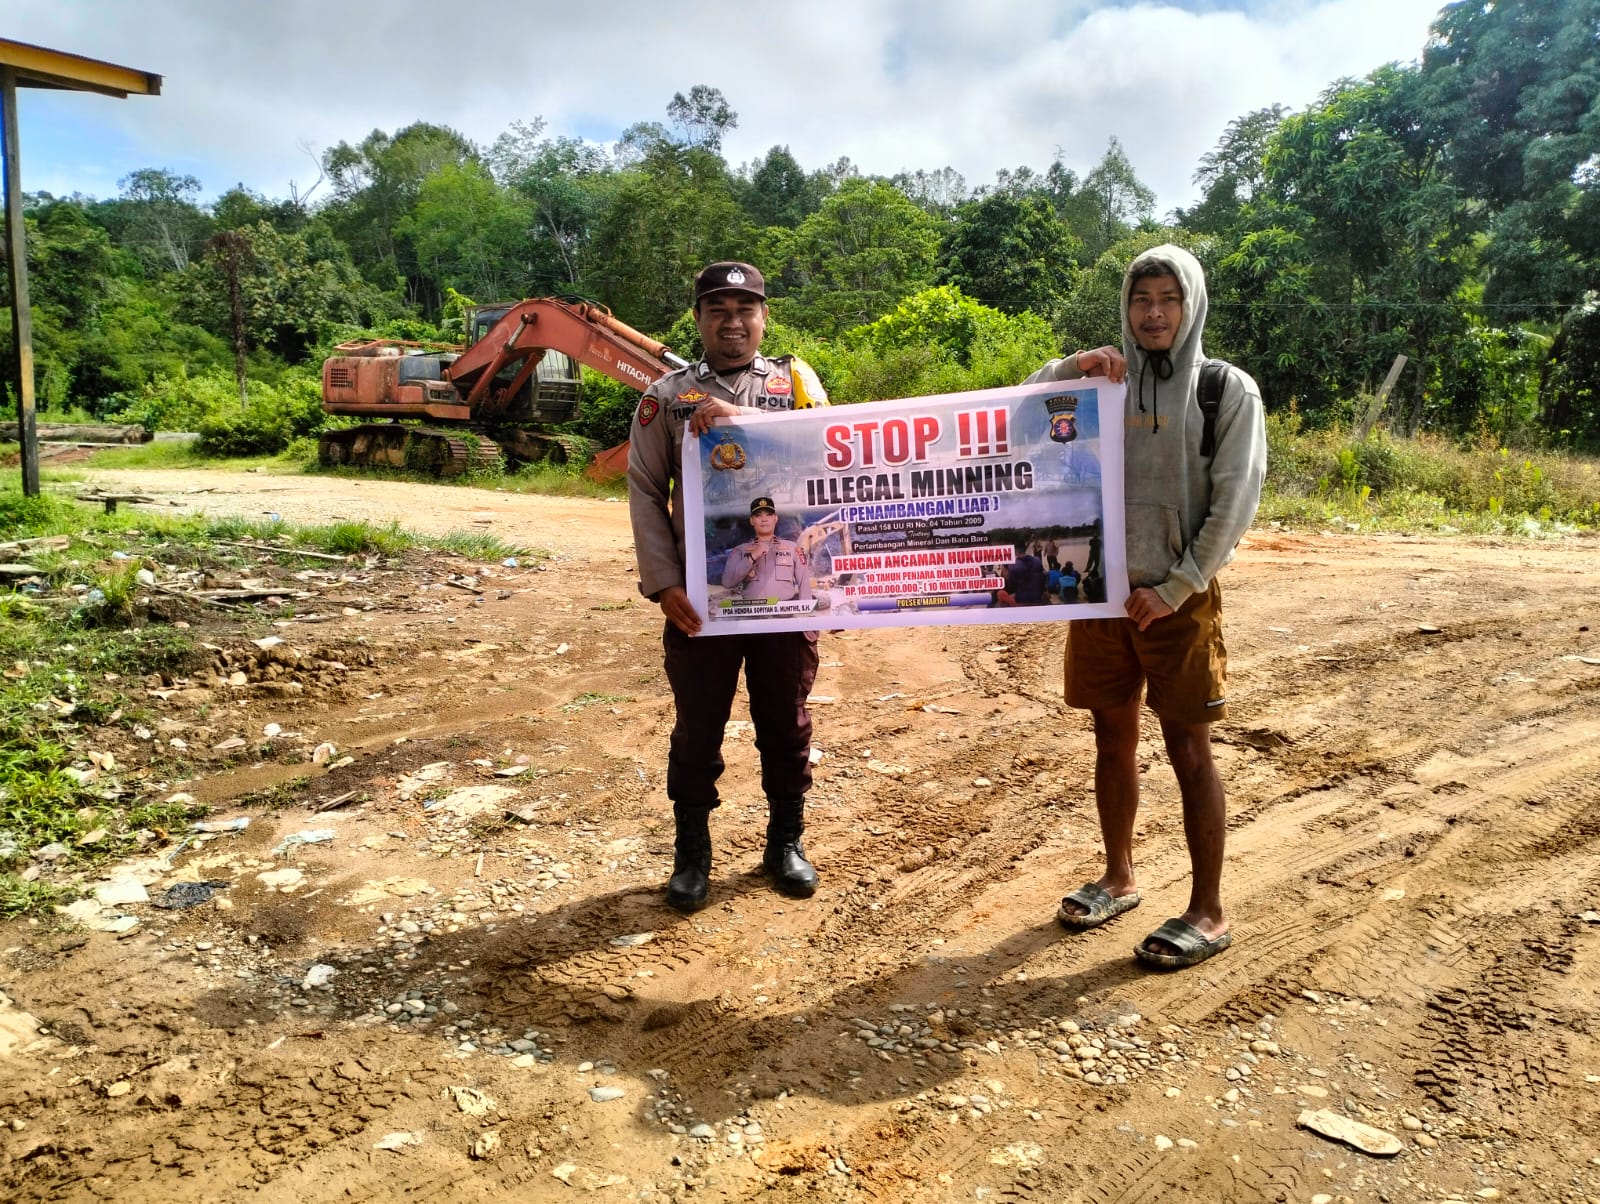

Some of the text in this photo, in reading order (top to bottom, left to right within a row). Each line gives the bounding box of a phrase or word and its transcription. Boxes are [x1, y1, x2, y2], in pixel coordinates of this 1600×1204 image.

[617, 359, 652, 386] HITACHI
[826, 408, 1009, 469] STOP !!!
[806, 461, 1034, 506] ILLEGAL MINNING
[849, 500, 955, 522] PENAMBANGAN
[958, 497, 990, 514] LIAR
[857, 524, 877, 532] Pasal
[879, 523, 891, 531] 158
[916, 521, 928, 529] No.
[940, 519, 963, 527] Tahun
[965, 517, 982, 525] 2009
[854, 540, 906, 551] Pertambangan
[907, 538, 933, 547] Mineral
[952, 536, 969, 544] Batu
[971, 535, 988, 543] Bara
[834, 548, 1012, 572] DENGAN ANCAMAN HUKUMAN
[866, 567, 980, 583] 10 TAHUN PENJARA DAN DENDA
[928, 582, 938, 591] 10
[939, 580, 967, 590] MILYAR
[969, 579, 998, 589] RUPIAH
[897, 596, 949, 607] POLSEK MARIKIT
